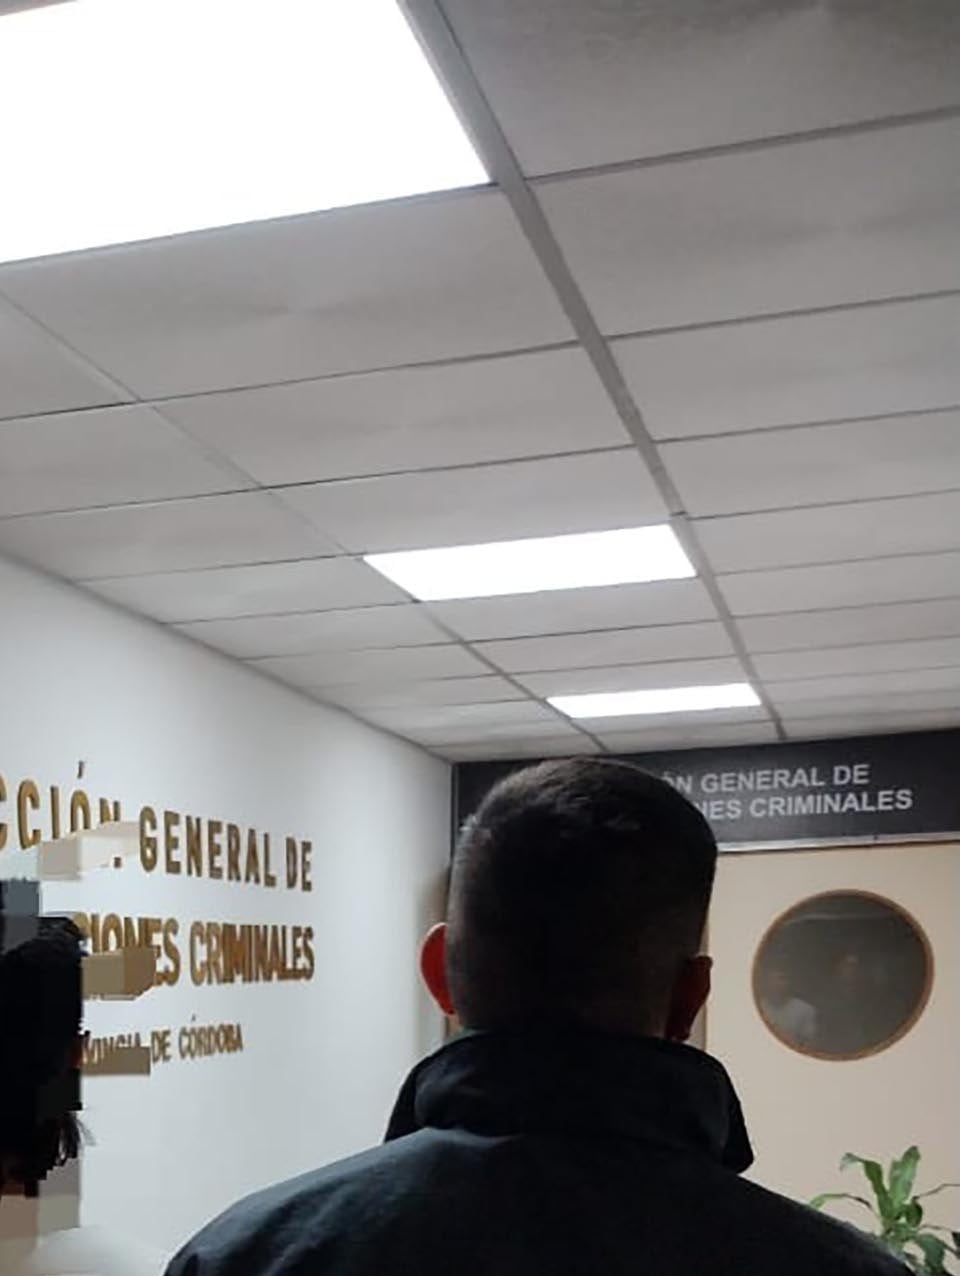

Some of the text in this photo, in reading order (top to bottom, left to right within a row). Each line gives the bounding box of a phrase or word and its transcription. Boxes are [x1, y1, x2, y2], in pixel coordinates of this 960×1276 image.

[700, 766, 826, 794] GENERAL
[833, 763, 870, 786] DE
[748, 788, 914, 818] CRIMINALES
[139, 806, 277, 888] GENERAL
[285, 836, 313, 892] DE
[190, 920, 315, 986] CRIMINALES
[150, 1029, 172, 1064] DE
